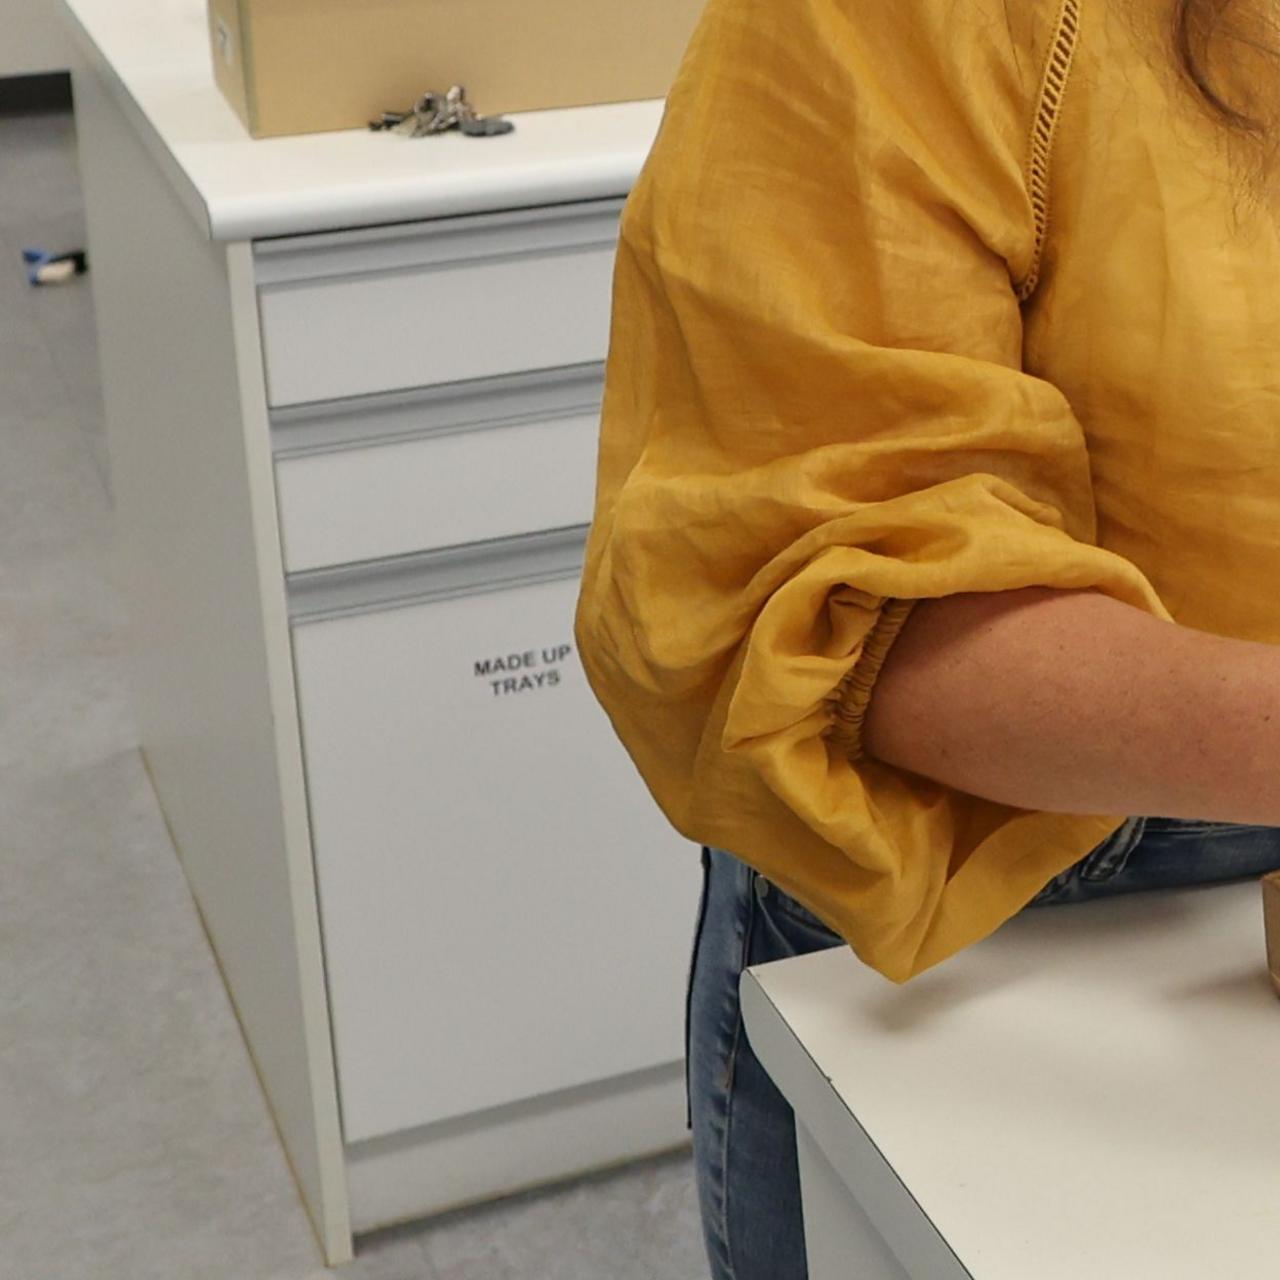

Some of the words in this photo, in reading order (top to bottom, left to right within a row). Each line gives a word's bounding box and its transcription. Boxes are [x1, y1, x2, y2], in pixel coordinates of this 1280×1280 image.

[474, 650, 537, 677] MADE
[542, 643, 571, 664] UP
[490, 668, 560, 696] TRAYS
